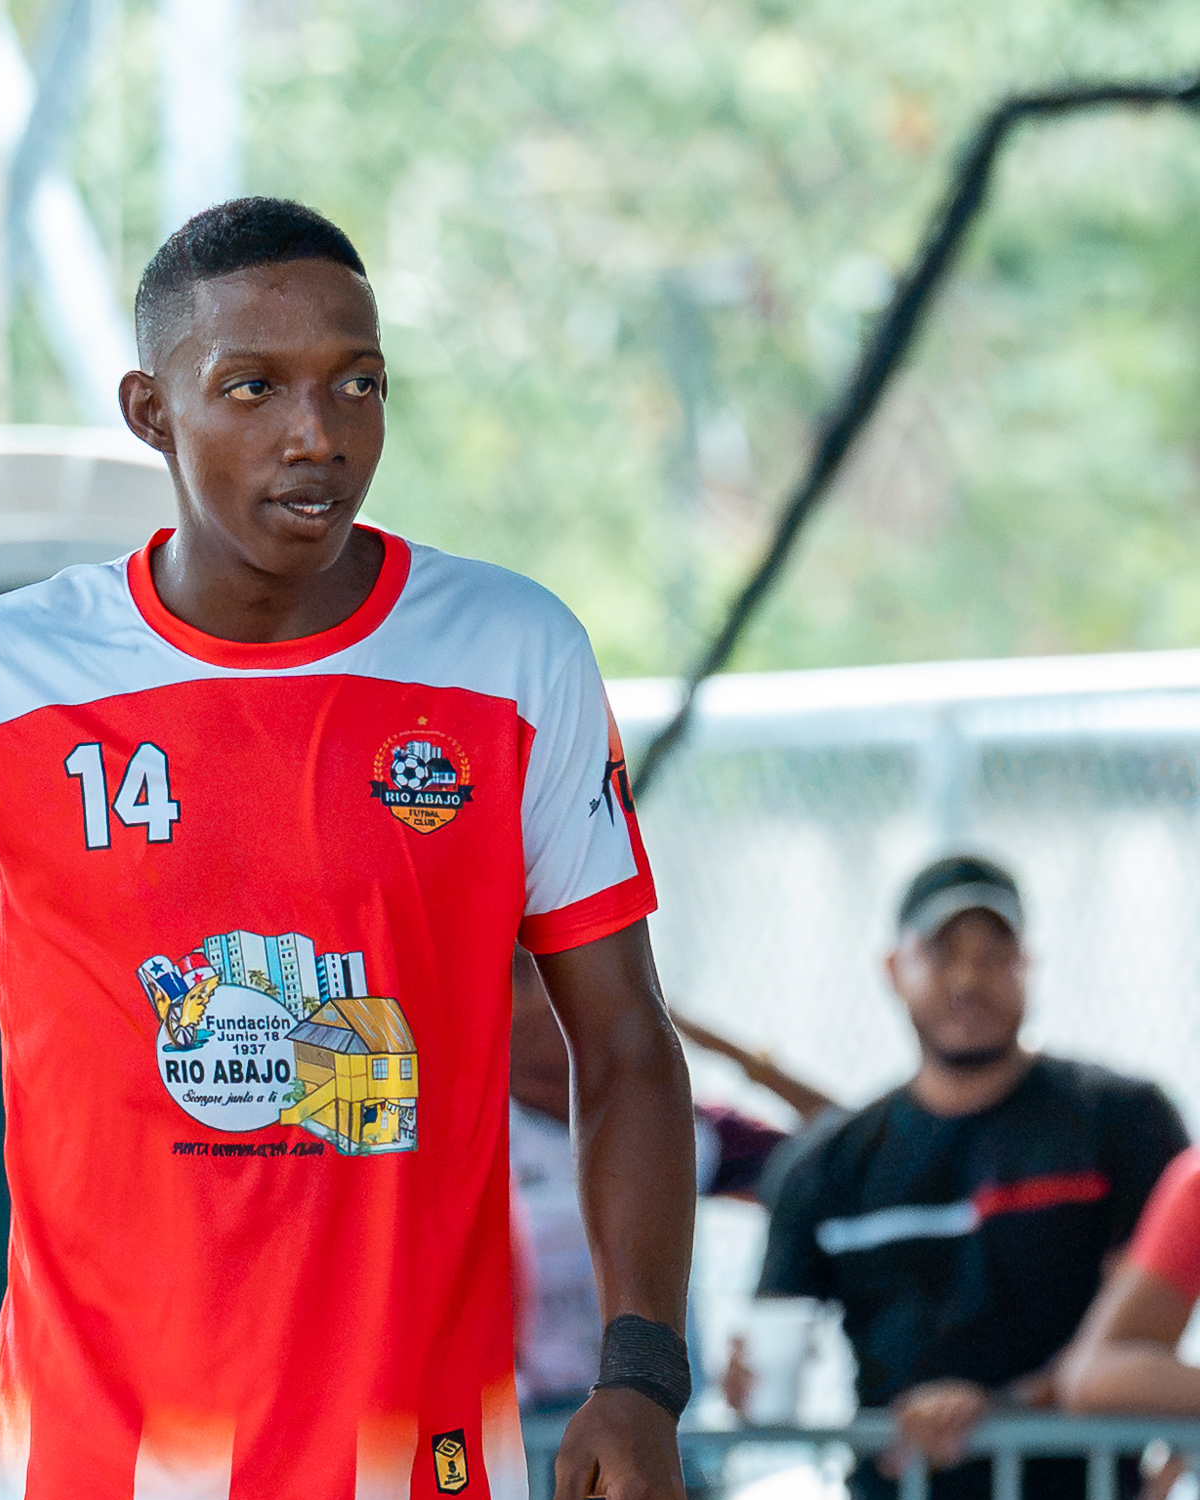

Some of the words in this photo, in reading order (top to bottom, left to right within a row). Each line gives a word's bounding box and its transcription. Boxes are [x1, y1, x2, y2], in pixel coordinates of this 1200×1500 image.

[65, 741, 180, 851] 14
[385, 791, 410, 803] RIO
[415, 793, 461, 805] ABAJO
[205, 1015, 291, 1030] Fundación
[217, 1031, 259, 1042] Junio
[264, 1031, 280, 1041] 18
[232, 1044, 266, 1055] 1937
[165, 1059, 205, 1084] RIO
[213, 1059, 291, 1084] ABAJO
[221, 1090, 254, 1106] junto
[256, 1095, 264, 1103] a
